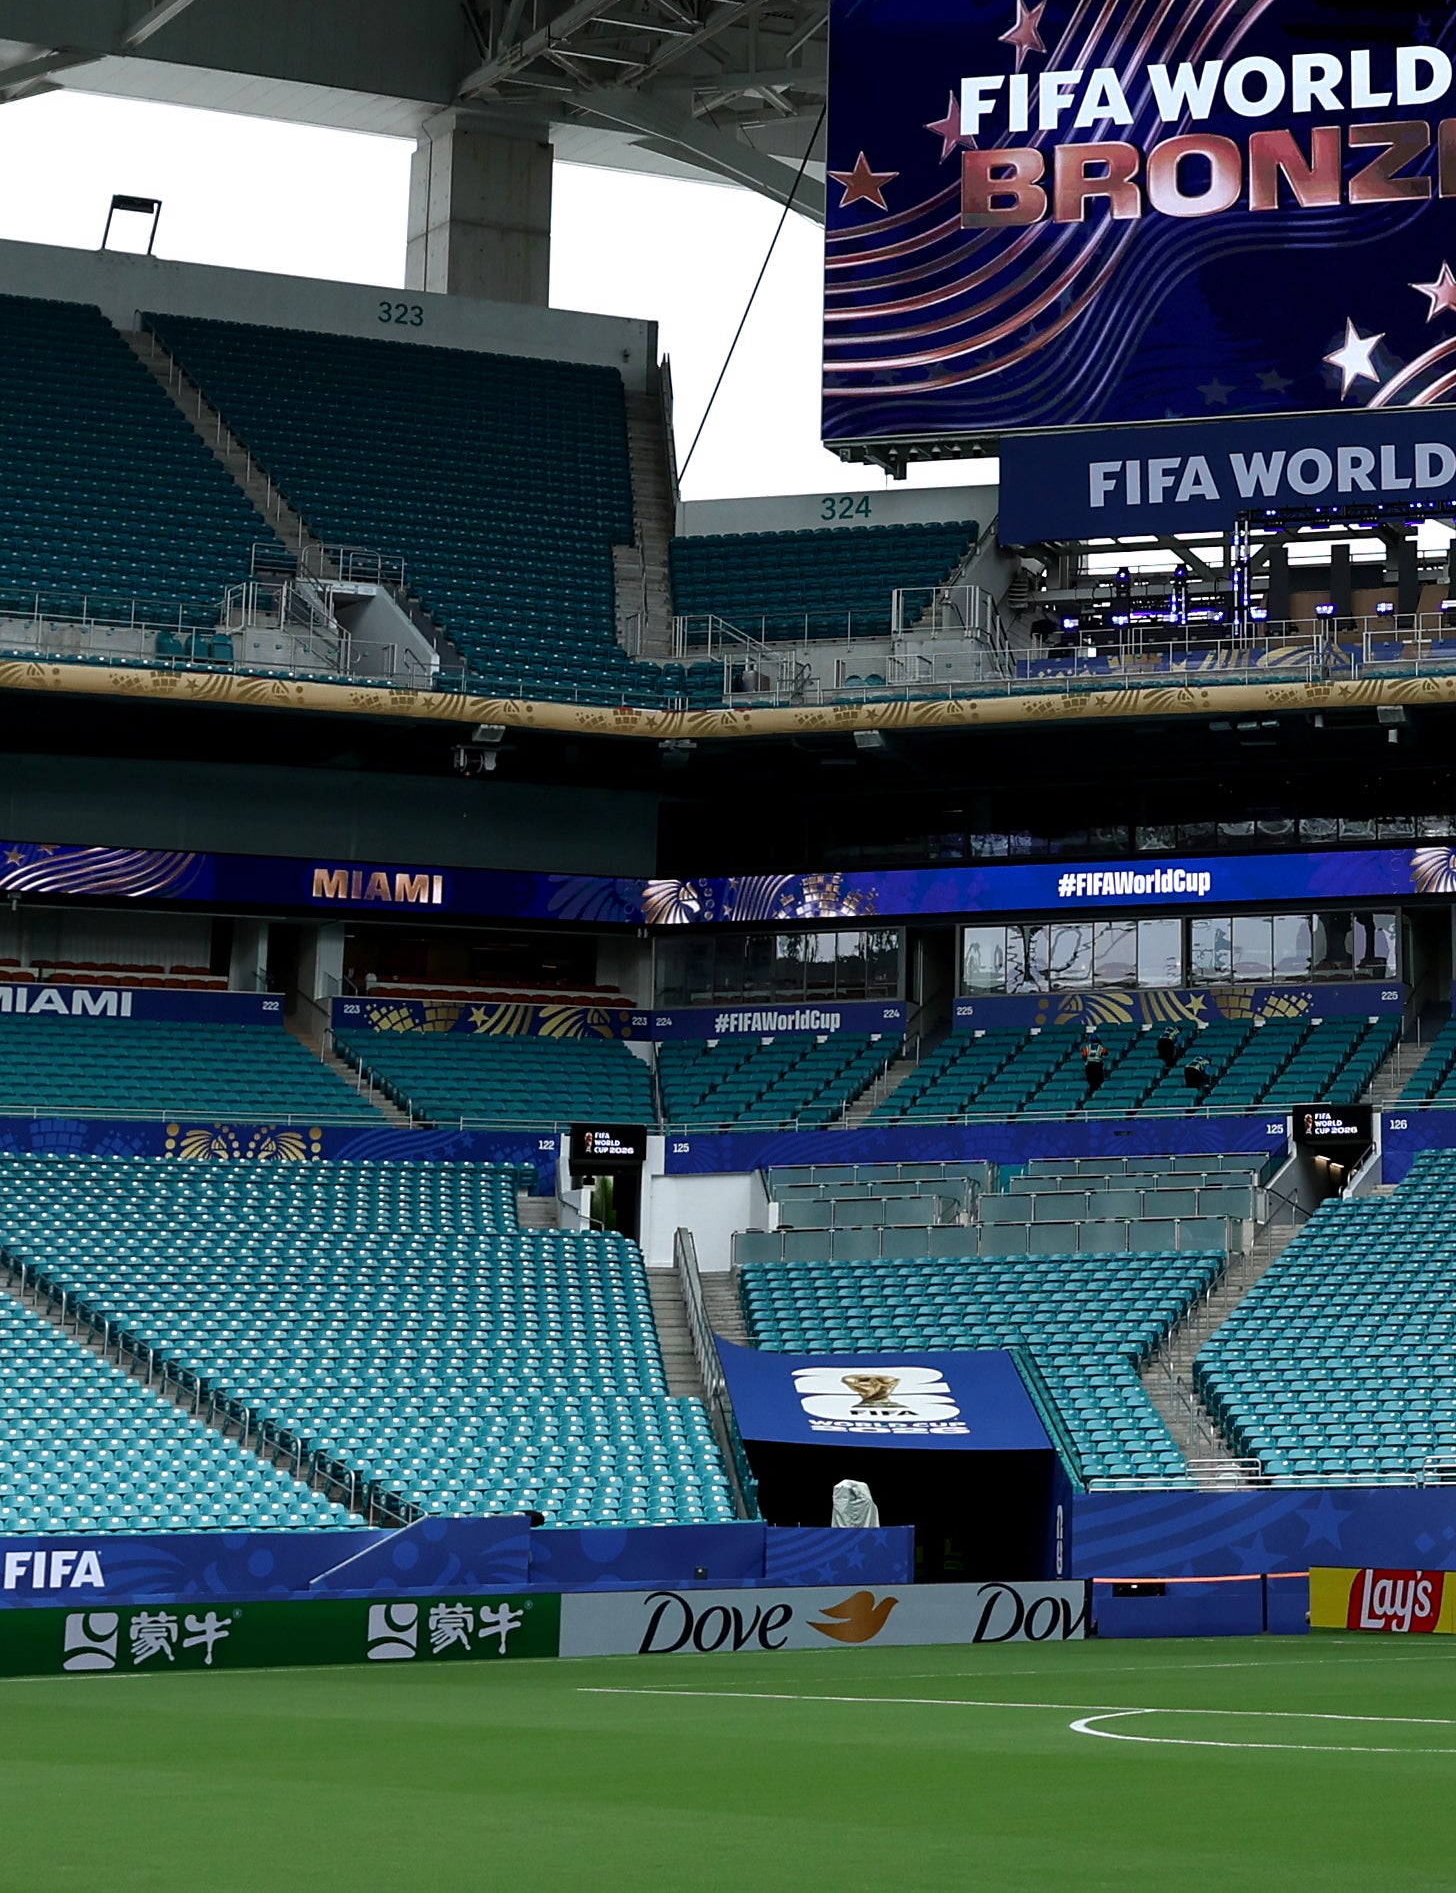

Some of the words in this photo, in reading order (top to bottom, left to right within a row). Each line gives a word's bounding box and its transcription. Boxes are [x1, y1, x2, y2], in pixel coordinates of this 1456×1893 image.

[960, 67, 1134, 135] FIFA
[1147, 45, 1453, 122] WORLD
[378, 301, 424, 327] 323
[1089, 455, 1219, 507] FIFA
[1229, 442, 1456, 498] WORLD
[821, 496, 872, 520] 324
[312, 868, 444, 904] MIAMI
[1058, 868, 1211, 898] #FIFAWorldCup
[1381, 990, 1398, 1001] 225
[262, 1000, 280, 1011] 222
[343, 1004, 361, 1015] 223
[956, 1006, 973, 1016] 225
[883, 1008, 900, 1019] 224
[632, 1016, 648, 1027] 223
[656, 1016, 673, 1027] 224
[715, 1010, 841, 1035] #FIFAWorldCup
[1315, 1112, 1331, 1120] FIFA
[1266, 1124, 1284, 1135] 125
[1389, 1119, 1407, 1130] 126
[538, 1140, 555, 1150] 122
[594, 1139, 620, 1147] WORLD
[672, 1143, 690, 1153] 125
[594, 1146, 609, 1154] CUP
[808, 1419, 908, 1428] WORLD
[917, 1420, 966, 1428] CUP
[811, 1425, 971, 1435] 2026
[4, 1550, 104, 1589] FIFA
[1360, 1568, 1433, 1632] Lay's
[972, 1582, 1085, 1644] Dov
[638, 1591, 793, 1654] Dove
[427, 1602, 525, 1655] 蒙牛
[130, 1611, 233, 1666] 蒙牛
